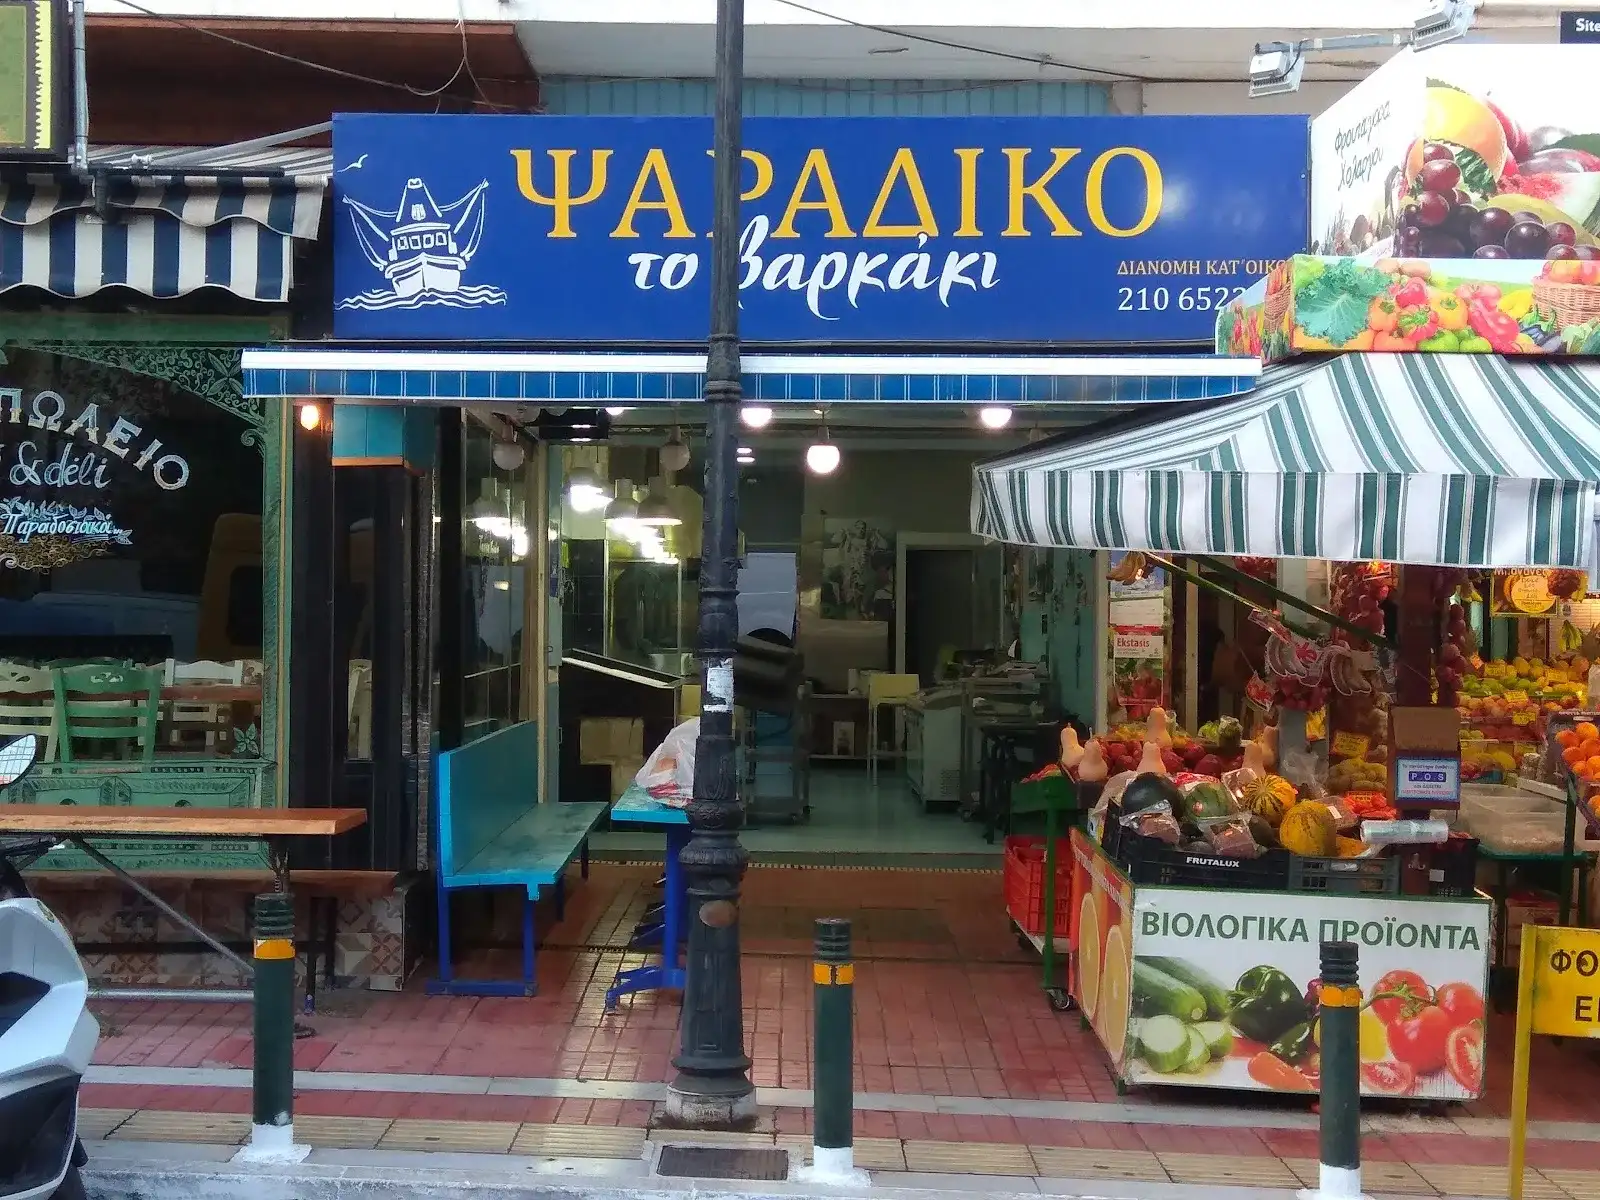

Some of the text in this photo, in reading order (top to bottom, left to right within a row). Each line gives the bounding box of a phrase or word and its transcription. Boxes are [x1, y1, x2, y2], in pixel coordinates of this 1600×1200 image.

[627, 252, 699, 290] το
[1117, 260, 1201, 276] ΔΙΑΝΟΜΗ
[1118, 286, 1170, 312] 210
[9, 441, 43, 486] &
[1116, 637, 1150, 649] Ekstasis
[1186, 856, 1240, 868] FRUTALUX
[1141, 911, 1481, 951] ΒΙΟΛΟΓΙΚΑ ΠΡΟΪΟΝΤΑ
